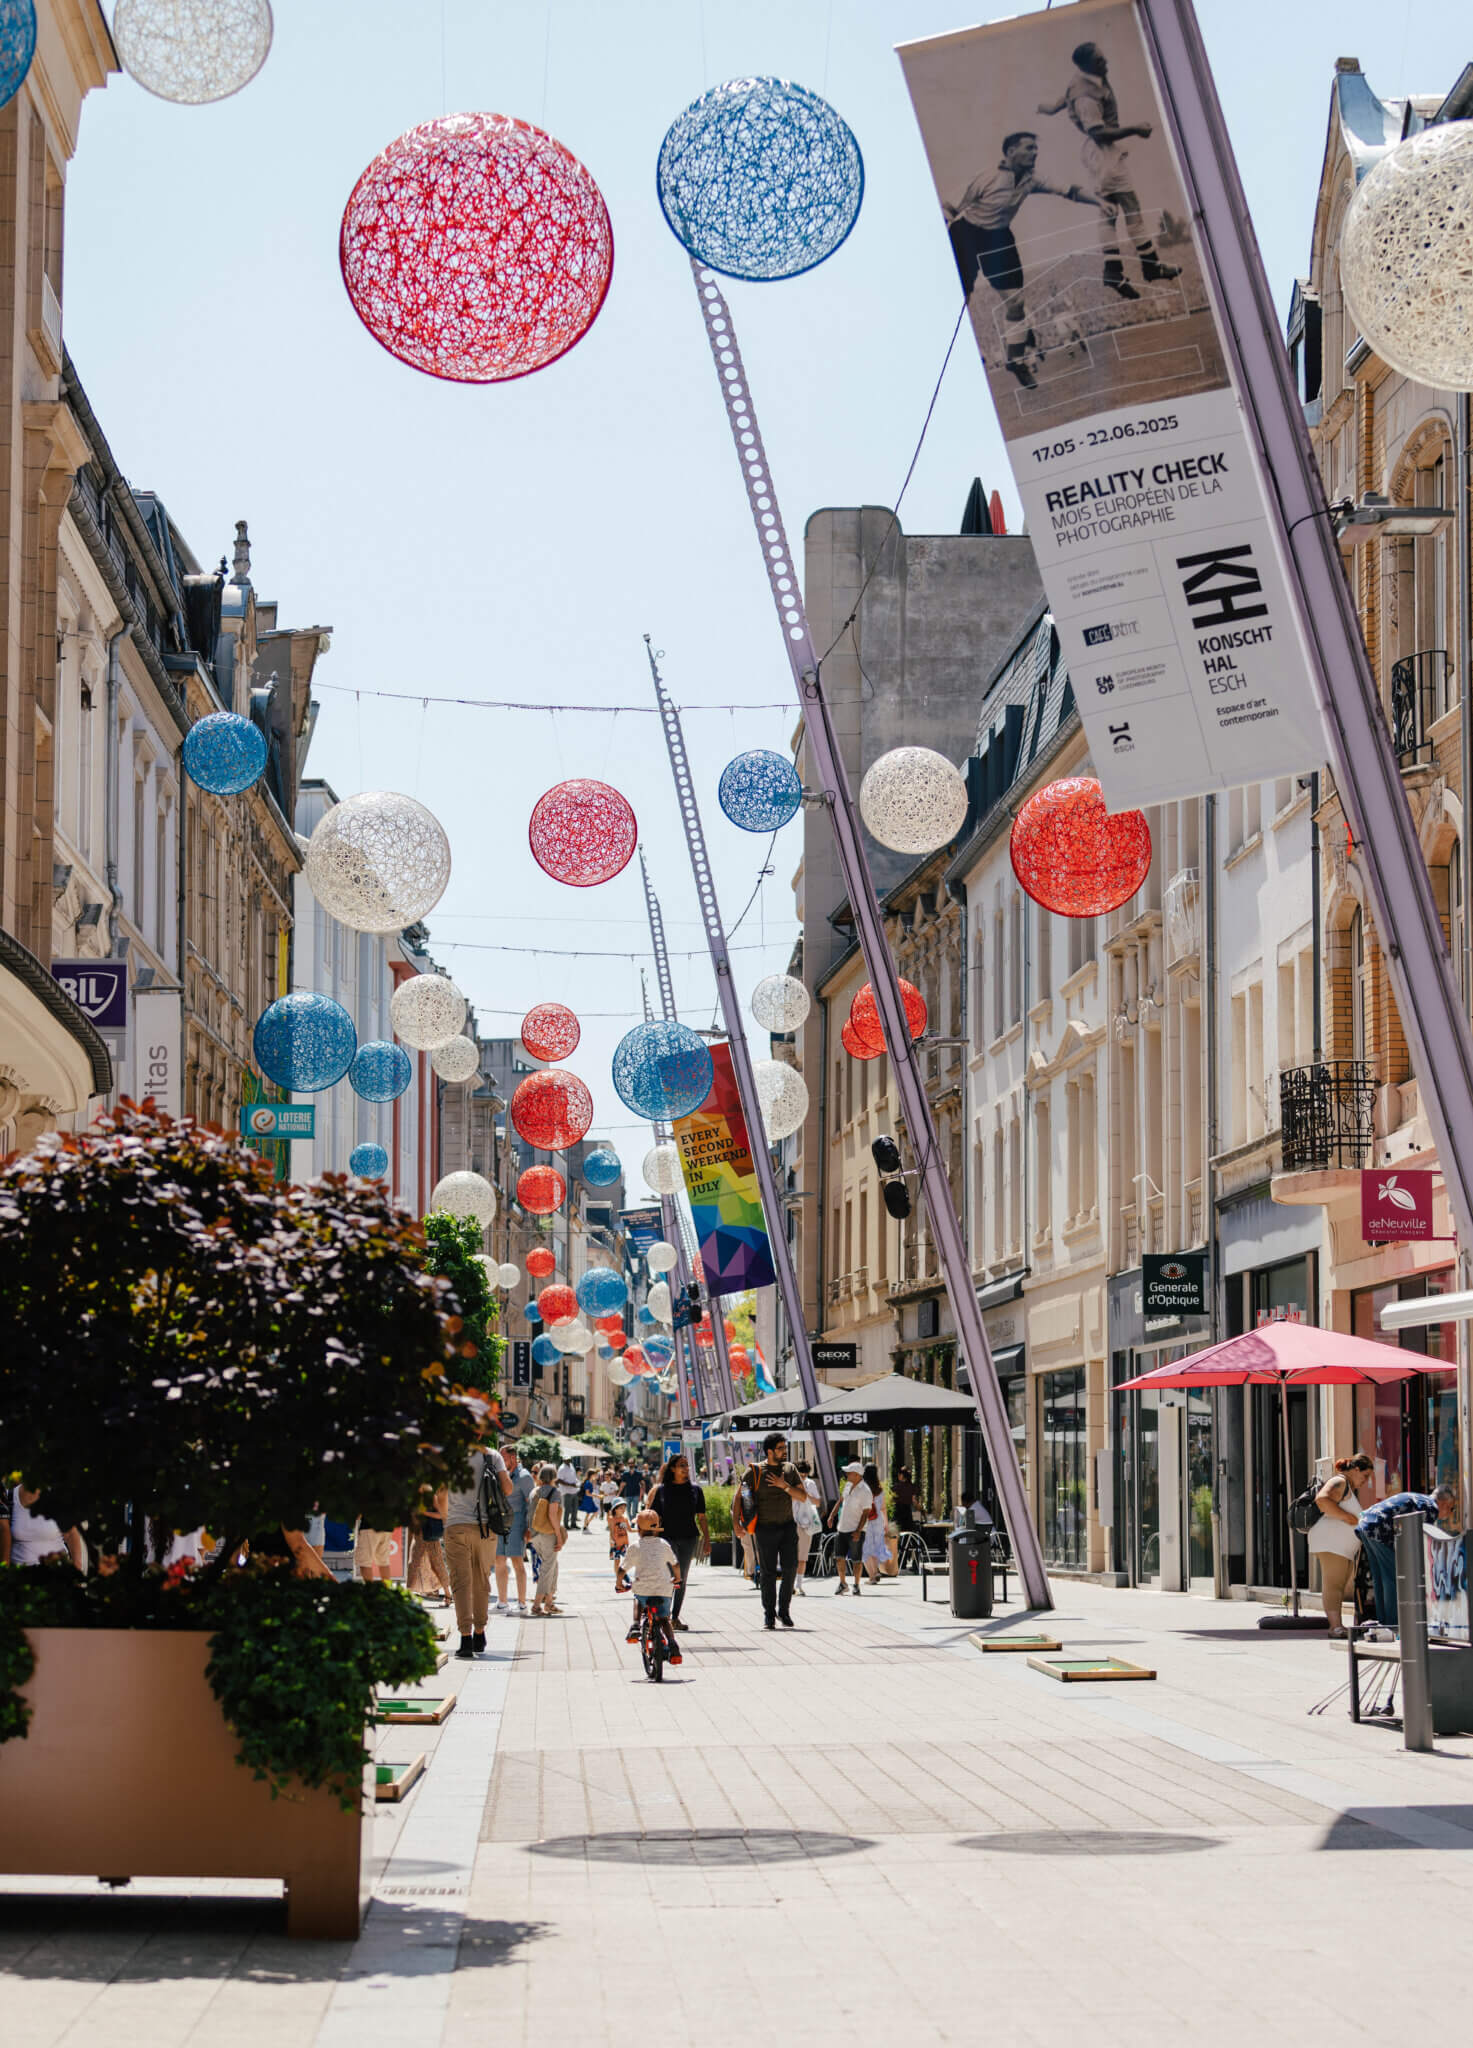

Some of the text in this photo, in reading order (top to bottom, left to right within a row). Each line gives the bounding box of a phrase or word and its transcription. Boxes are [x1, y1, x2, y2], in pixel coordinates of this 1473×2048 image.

[1032, 439, 1076, 463] 17.05
[1087, 415, 1179, 447] 22.06.2025
[1045, 452, 1229, 512] REALITY CHECK
[1051, 478, 1224, 530] MOIS EUROPÉEN DE LA
[1055, 506, 1176, 548] PHOTOGRAPHIE
[1198, 625, 1273, 655] KONSCHT
[1203, 655, 1238, 675] HAL
[1208, 672, 1247, 695] ESCH
[1216, 697, 1267, 716] Espace d'art
[1219, 708, 1279, 728] contemporain
[59, 978, 104, 1004] BIL
[278, 1112, 312, 1122] LOTERIE
[278, 1123, 312, 1131] NATIONALE
[681, 1127, 720, 1145] EVERY
[684, 1137, 734, 1157] SECOND
[686, 1148, 748, 1169] WEEKEND
[689, 1171, 703, 1183] IN
[692, 1179, 720, 1197] JULY
[1149, 1281, 1199, 1293] Generale
[1147, 1294, 1200, 1307] d'Optique
[749, 1417, 792, 1428] PEPSI
[823, 1412, 868, 1426] PEPSI
